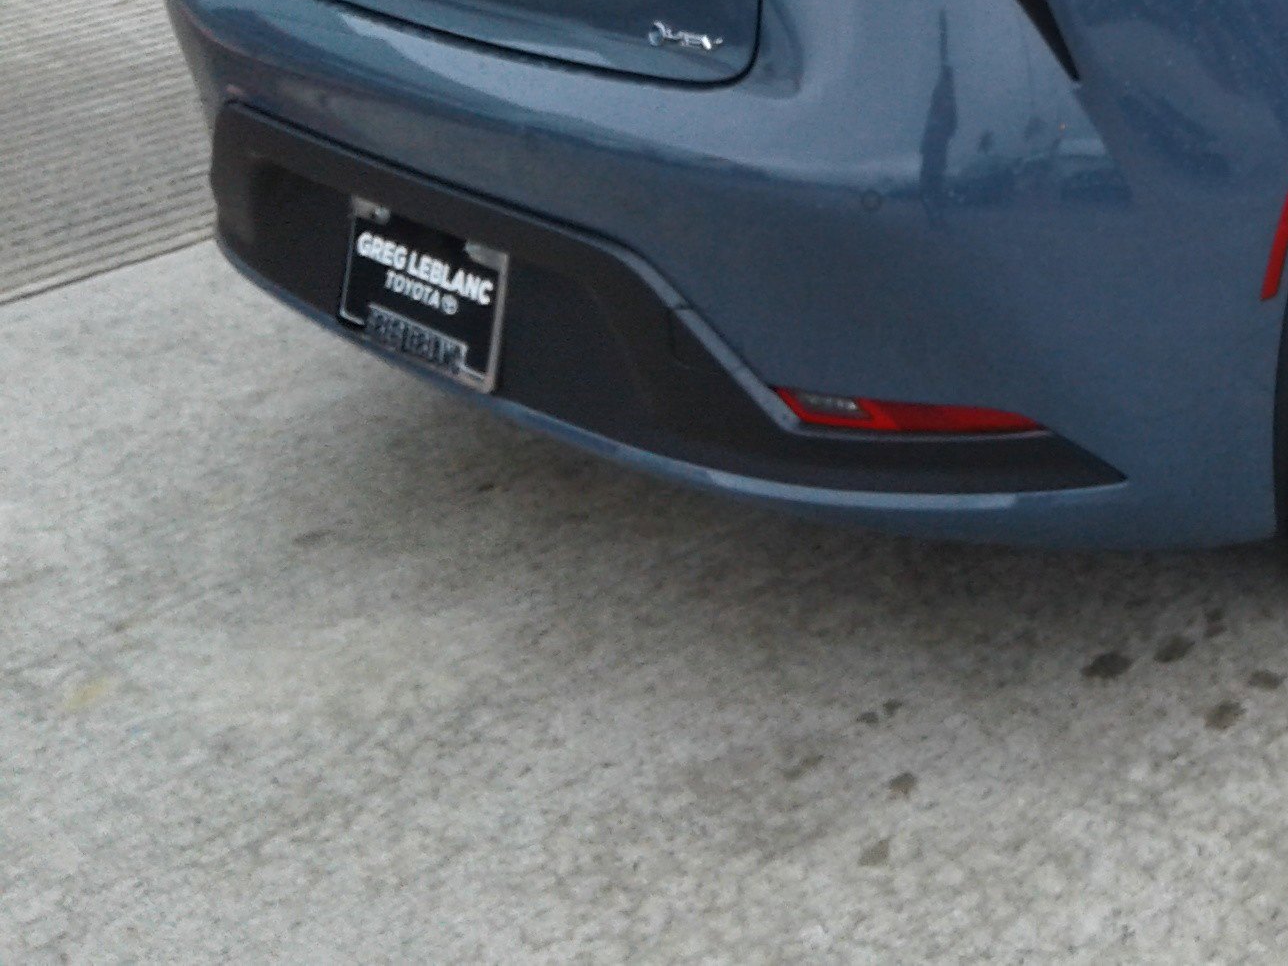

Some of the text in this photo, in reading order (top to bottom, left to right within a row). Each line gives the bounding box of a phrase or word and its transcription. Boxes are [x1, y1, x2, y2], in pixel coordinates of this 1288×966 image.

[356, 231, 494, 306] GREG LEBLANC
[385, 269, 441, 310] TOYOTA
